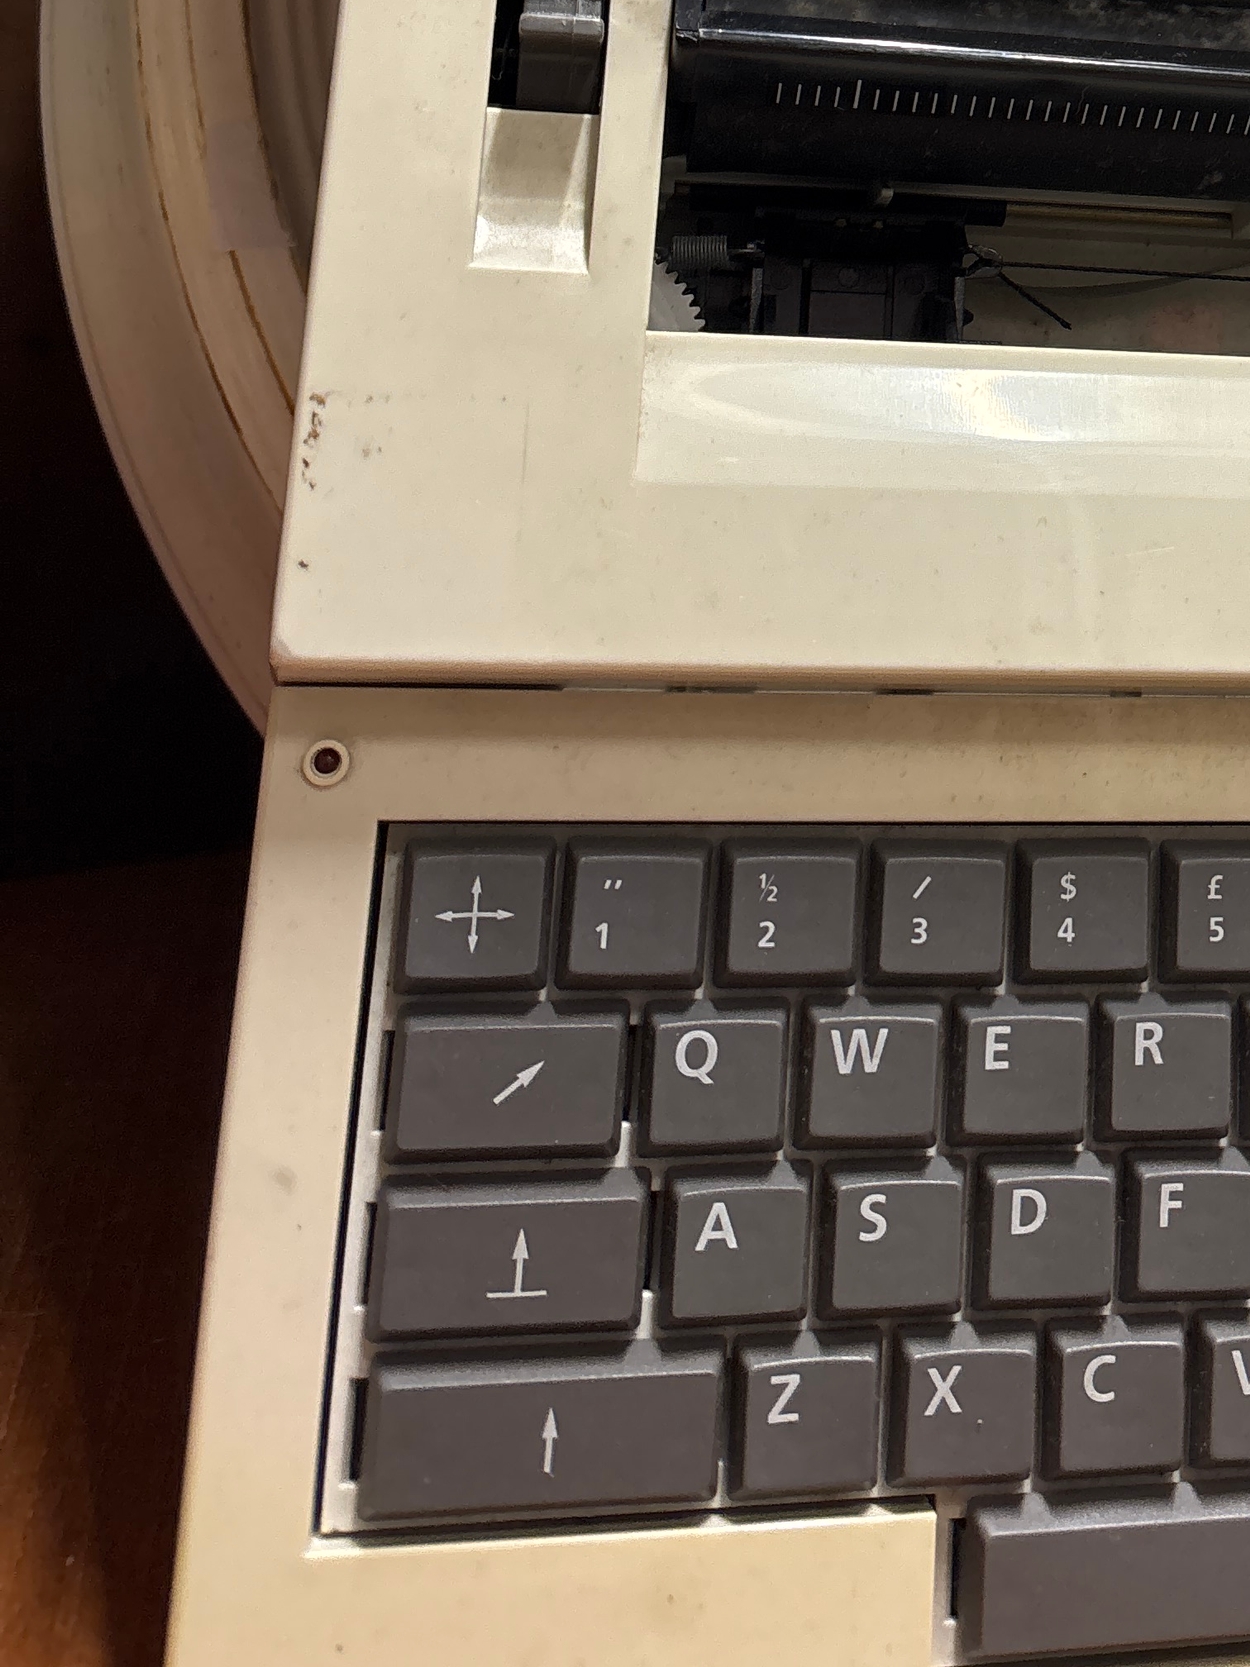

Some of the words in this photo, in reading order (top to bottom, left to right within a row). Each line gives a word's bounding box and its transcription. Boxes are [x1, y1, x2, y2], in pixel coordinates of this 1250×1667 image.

[1061, 872, 1076, 901] $
[1208, 875, 1223, 899] £
[596, 923, 608, 949] 1
[758, 921, 775, 947] 2
[911, 918, 927, 943] 3
[1058, 918, 1075, 942] 4
[1210, 917, 1223, 941] 5
[676, 1030, 717, 1084] Q
[831, 1029, 888, 1074] W
[985, 1026, 1011, 1070] E
[1135, 1022, 1163, 1065] R
[695, 1203, 737, 1251] A
[860, 1194, 886, 1241] S
[1012, 1189, 1046, 1234] D
[1160, 1183, 1183, 1227] F
[768, 1374, 800, 1423] Z
[925, 1366, 962, 1415] X
[1084, 1355, 1116, 1402] C
